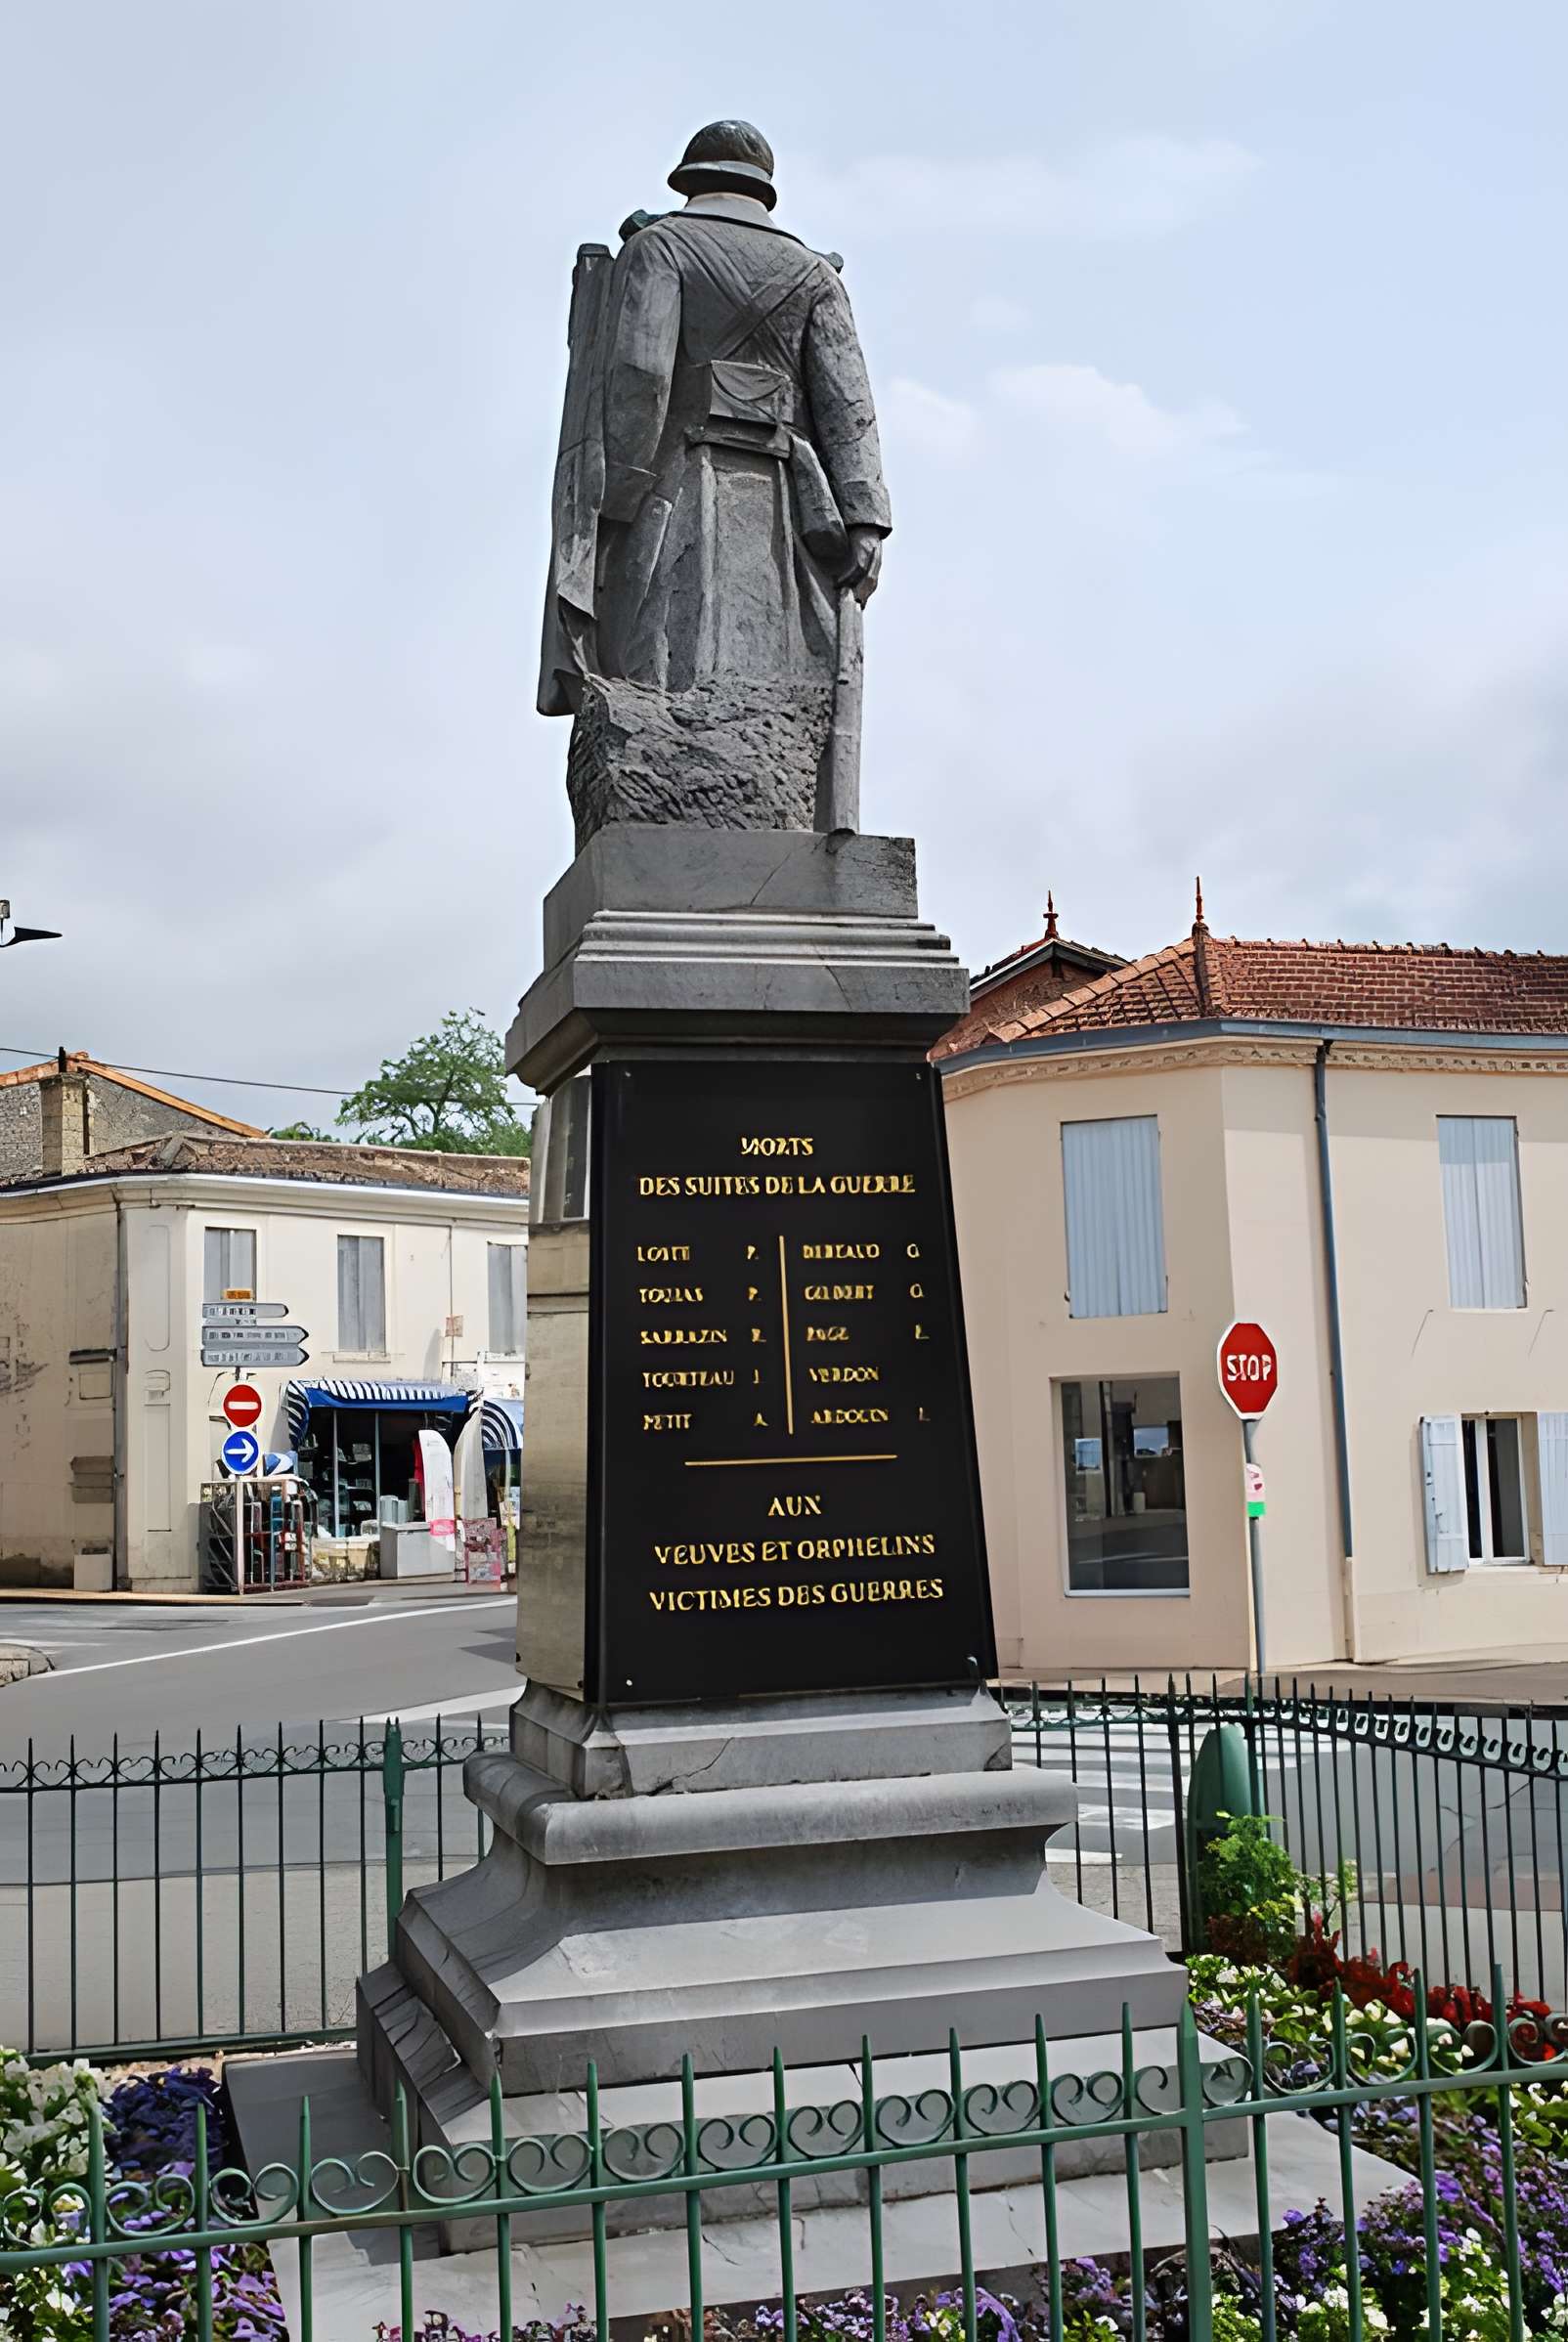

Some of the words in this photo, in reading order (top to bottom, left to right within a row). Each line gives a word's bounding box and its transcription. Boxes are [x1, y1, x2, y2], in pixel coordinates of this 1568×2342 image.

[740, 1137, 814, 1156] MORTS
[638, 1176, 680, 1195] DES
[684, 1176, 760, 1195] SUITES
[765, 1176, 793, 1194] DE
[798, 1176, 826, 1194] LA
[829, 1174, 916, 1194] GUERRE
[1227, 1354, 1272, 1381] STOP
[767, 1495, 822, 1517] AUX
[654, 1540, 756, 1566] VEUVES
[762, 1540, 792, 1562] ET
[797, 1534, 936, 1561] ORPHELINS
[649, 1586, 771, 1612] VICTIMES
[778, 1583, 825, 1607] DES
[830, 1578, 944, 1604] GUERRES
